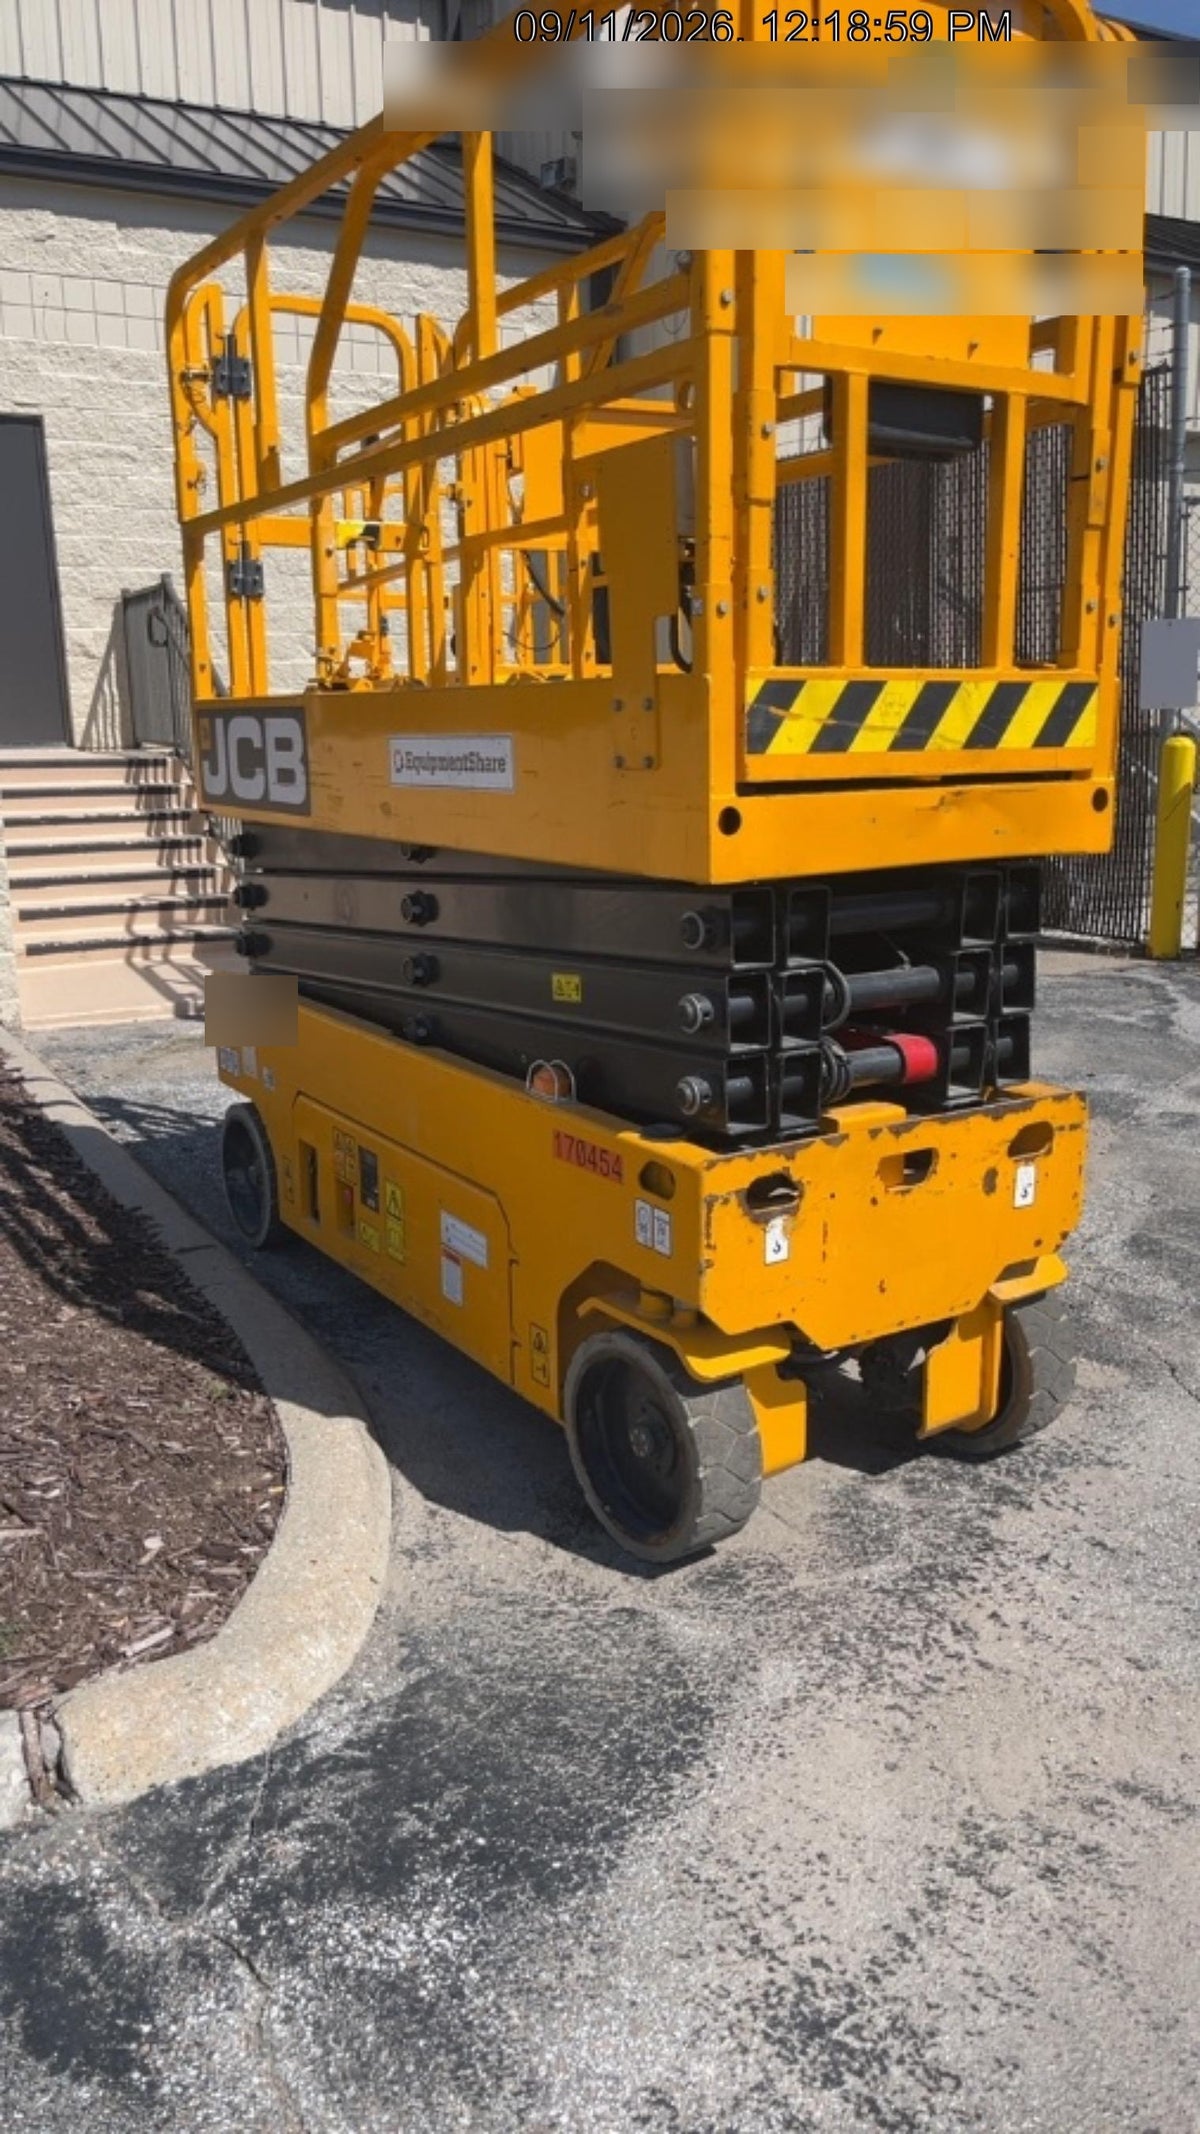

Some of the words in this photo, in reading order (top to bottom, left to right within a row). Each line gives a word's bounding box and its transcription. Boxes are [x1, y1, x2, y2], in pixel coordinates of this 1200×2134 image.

[201, 715, 307, 805] JCB
[404, 750, 507, 776] EquipmentShare
[553, 1130, 624, 1183] 170454
